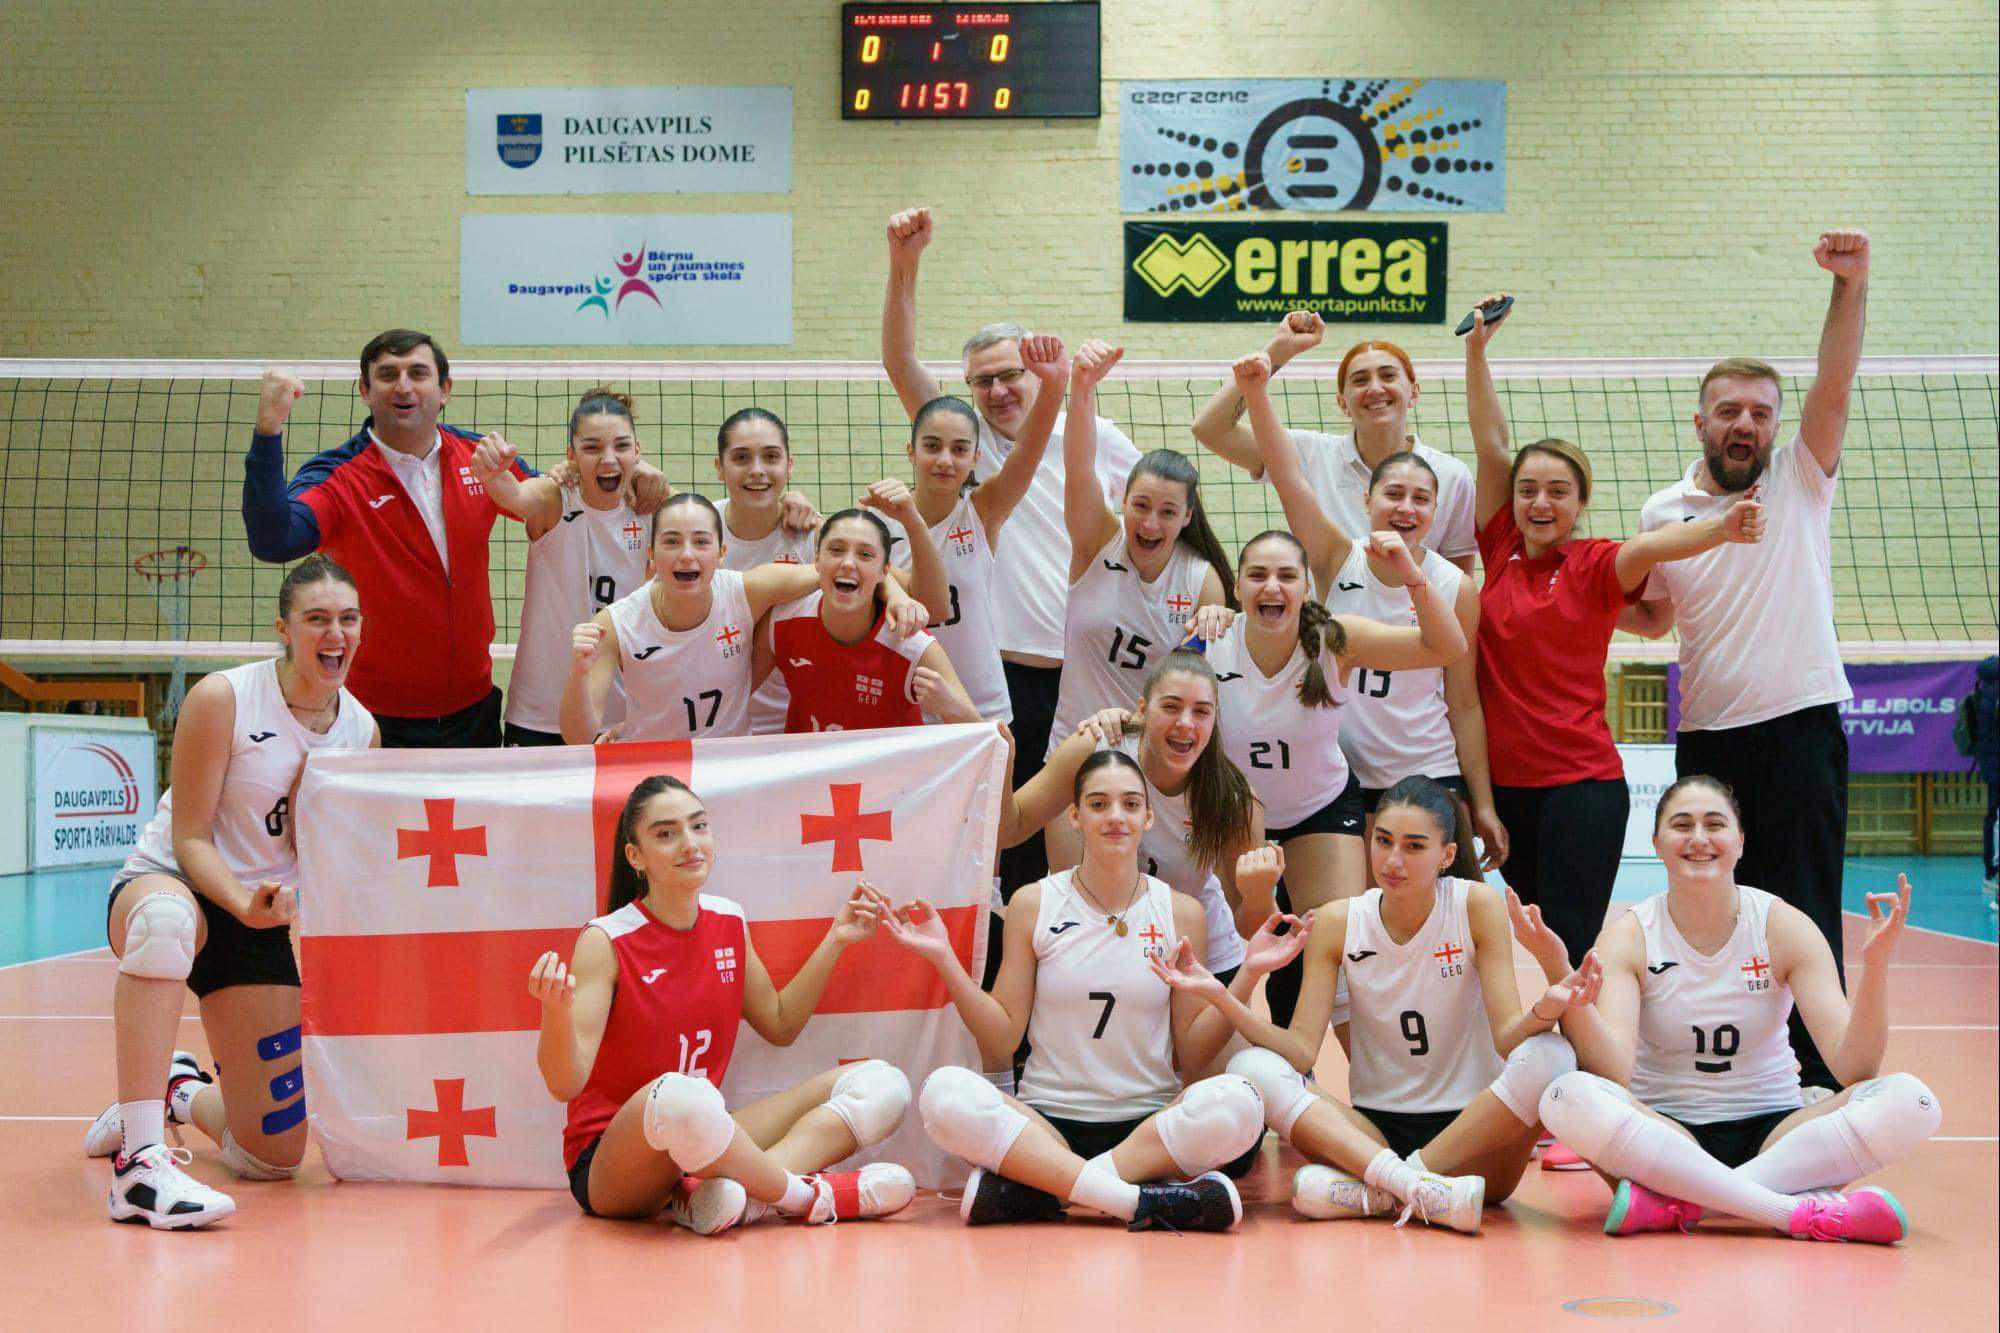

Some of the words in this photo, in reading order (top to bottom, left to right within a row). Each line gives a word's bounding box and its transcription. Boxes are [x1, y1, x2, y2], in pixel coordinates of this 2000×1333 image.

[861, 35, 881, 63] 0
[932, 41, 940, 61] 1
[989, 34, 1010, 62] 0
[854, 89, 871, 110] 0
[994, 88, 1010, 109] 0
[563, 116, 713, 136] DAUGAVPILS
[563, 141, 675, 164] PILSĒTAS
[681, 143, 756, 163] DOME
[647, 272, 697, 282] sporta
[702, 271, 742, 281] skola
[648, 262, 667, 272] un
[671, 261, 745, 273] jaunatnes
[508, 283, 593, 296] Daugavpils
[1236, 297, 1427, 315] www.sportapunkts.lv
[956, 543, 974, 558] GEO
[1168, 613, 1187, 625] GEO
[722, 644, 741, 659] GEO
[1108, 626, 1153, 670] 15
[857, 695, 878, 705] GEO
[682, 688, 722, 732] 17
[1841, 719, 1916, 736] TVIJA
[1249, 738, 1290, 770] 21
[54, 789, 125, 808] DAUGAVPILS
[54, 827, 92, 850] SPORTA
[1440, 964, 1462, 978] GEO
[1747, 978, 1769, 992] GEO
[1088, 992, 1116, 1040] 7
[1399, 1010, 1430, 1056] 9
[1691, 1024, 1739, 1057] 10
[678, 1029, 712, 1079] 12
